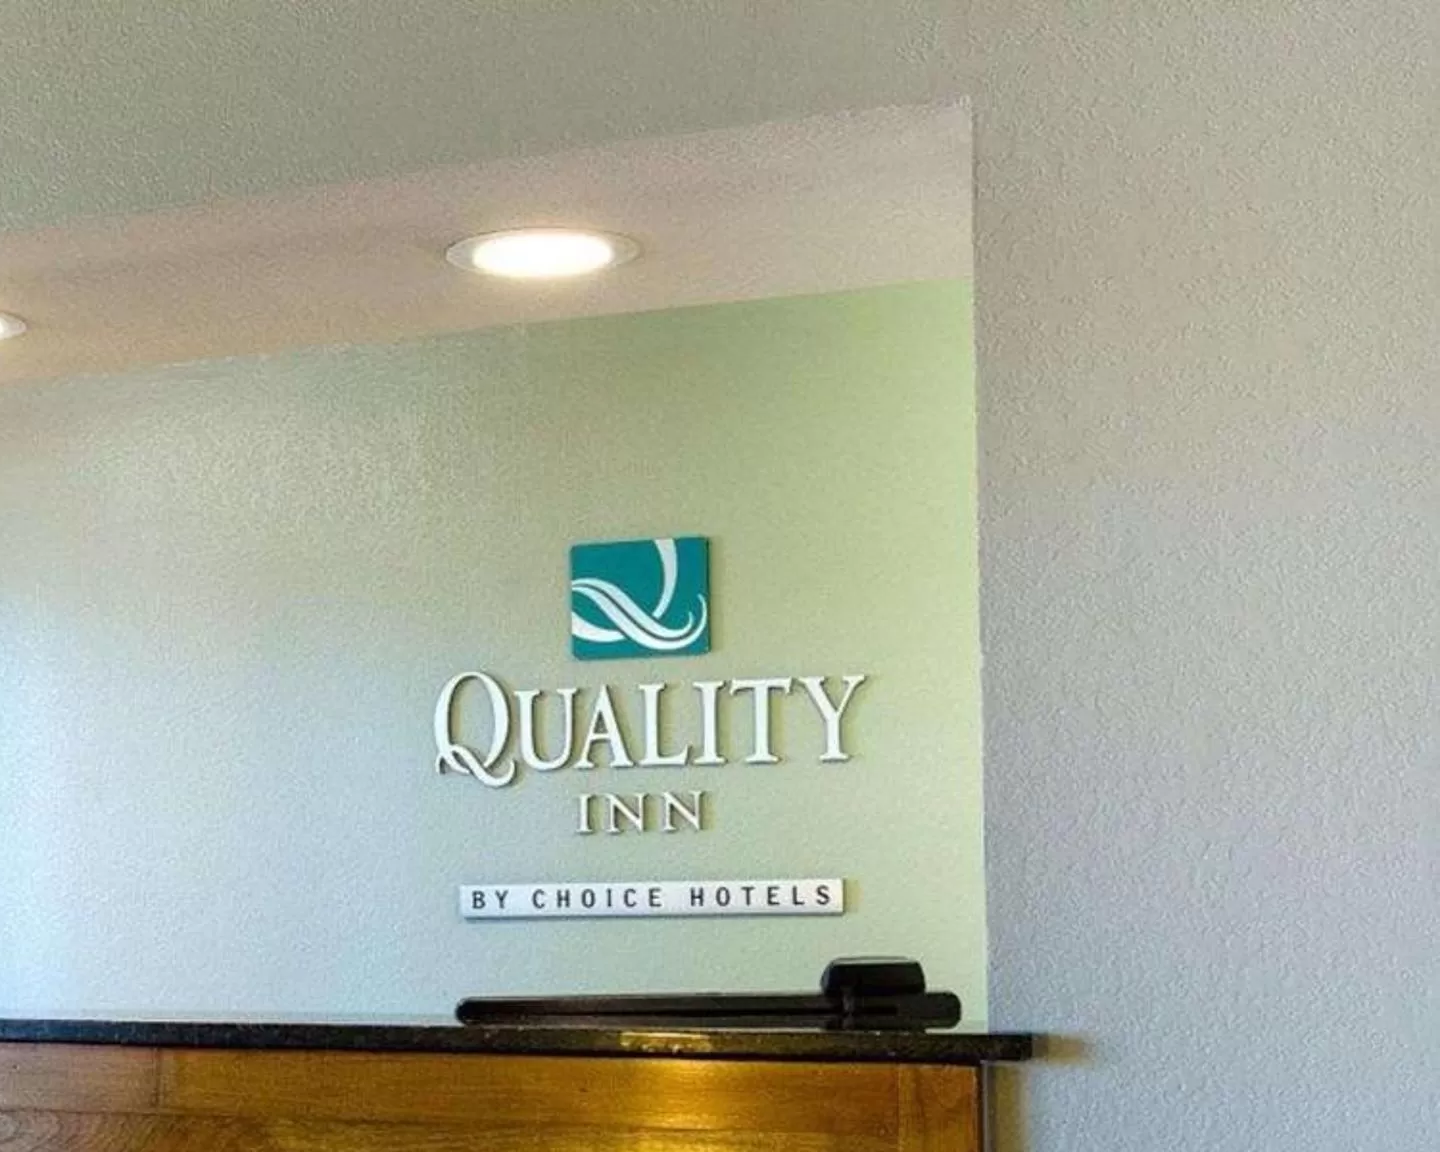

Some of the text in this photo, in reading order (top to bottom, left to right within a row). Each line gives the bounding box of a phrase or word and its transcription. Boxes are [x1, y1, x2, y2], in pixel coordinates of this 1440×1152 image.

[433, 671, 865, 788] QUALITY
[576, 790, 706, 834] INN
[472, 885, 831, 909] BY CHOICE HOTELS
